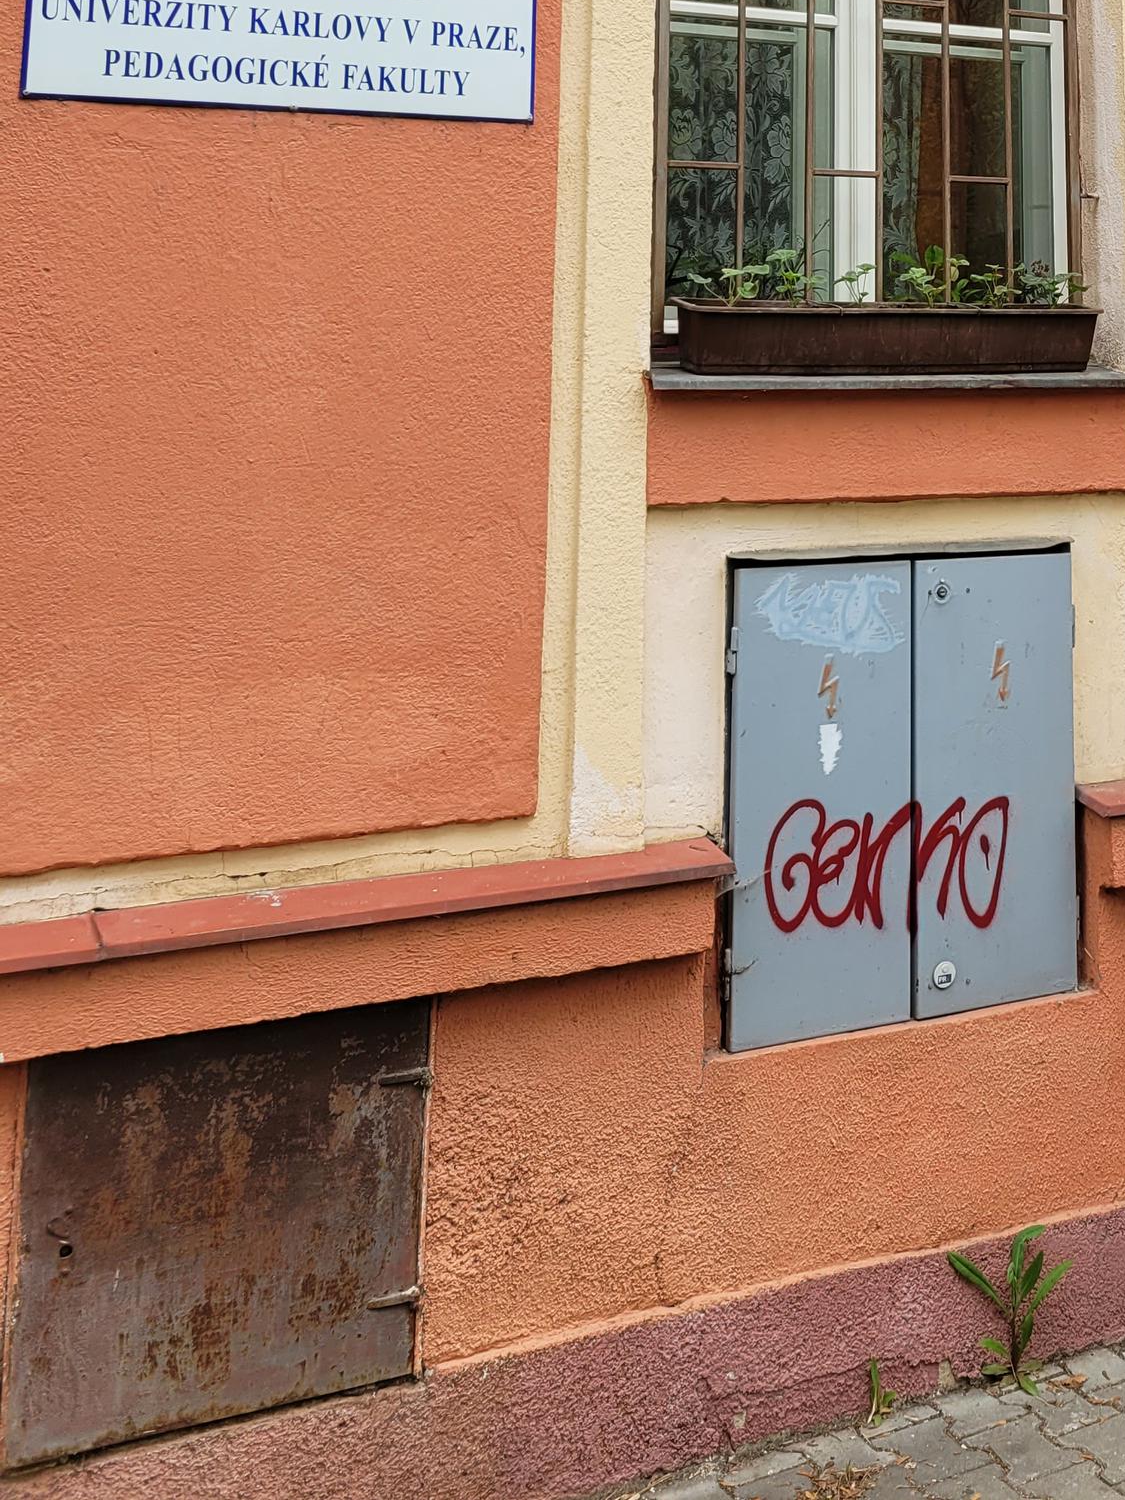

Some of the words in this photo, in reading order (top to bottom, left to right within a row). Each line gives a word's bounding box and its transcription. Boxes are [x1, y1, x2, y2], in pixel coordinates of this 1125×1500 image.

[248, 7, 393, 43] KARLOVY
[402, 18, 422, 45] V
[430, 21, 526, 58] PRAZE,
[102, 48, 329, 89] PEDAGOGICKÉ
[341, 63, 471, 97] FAKULTY
